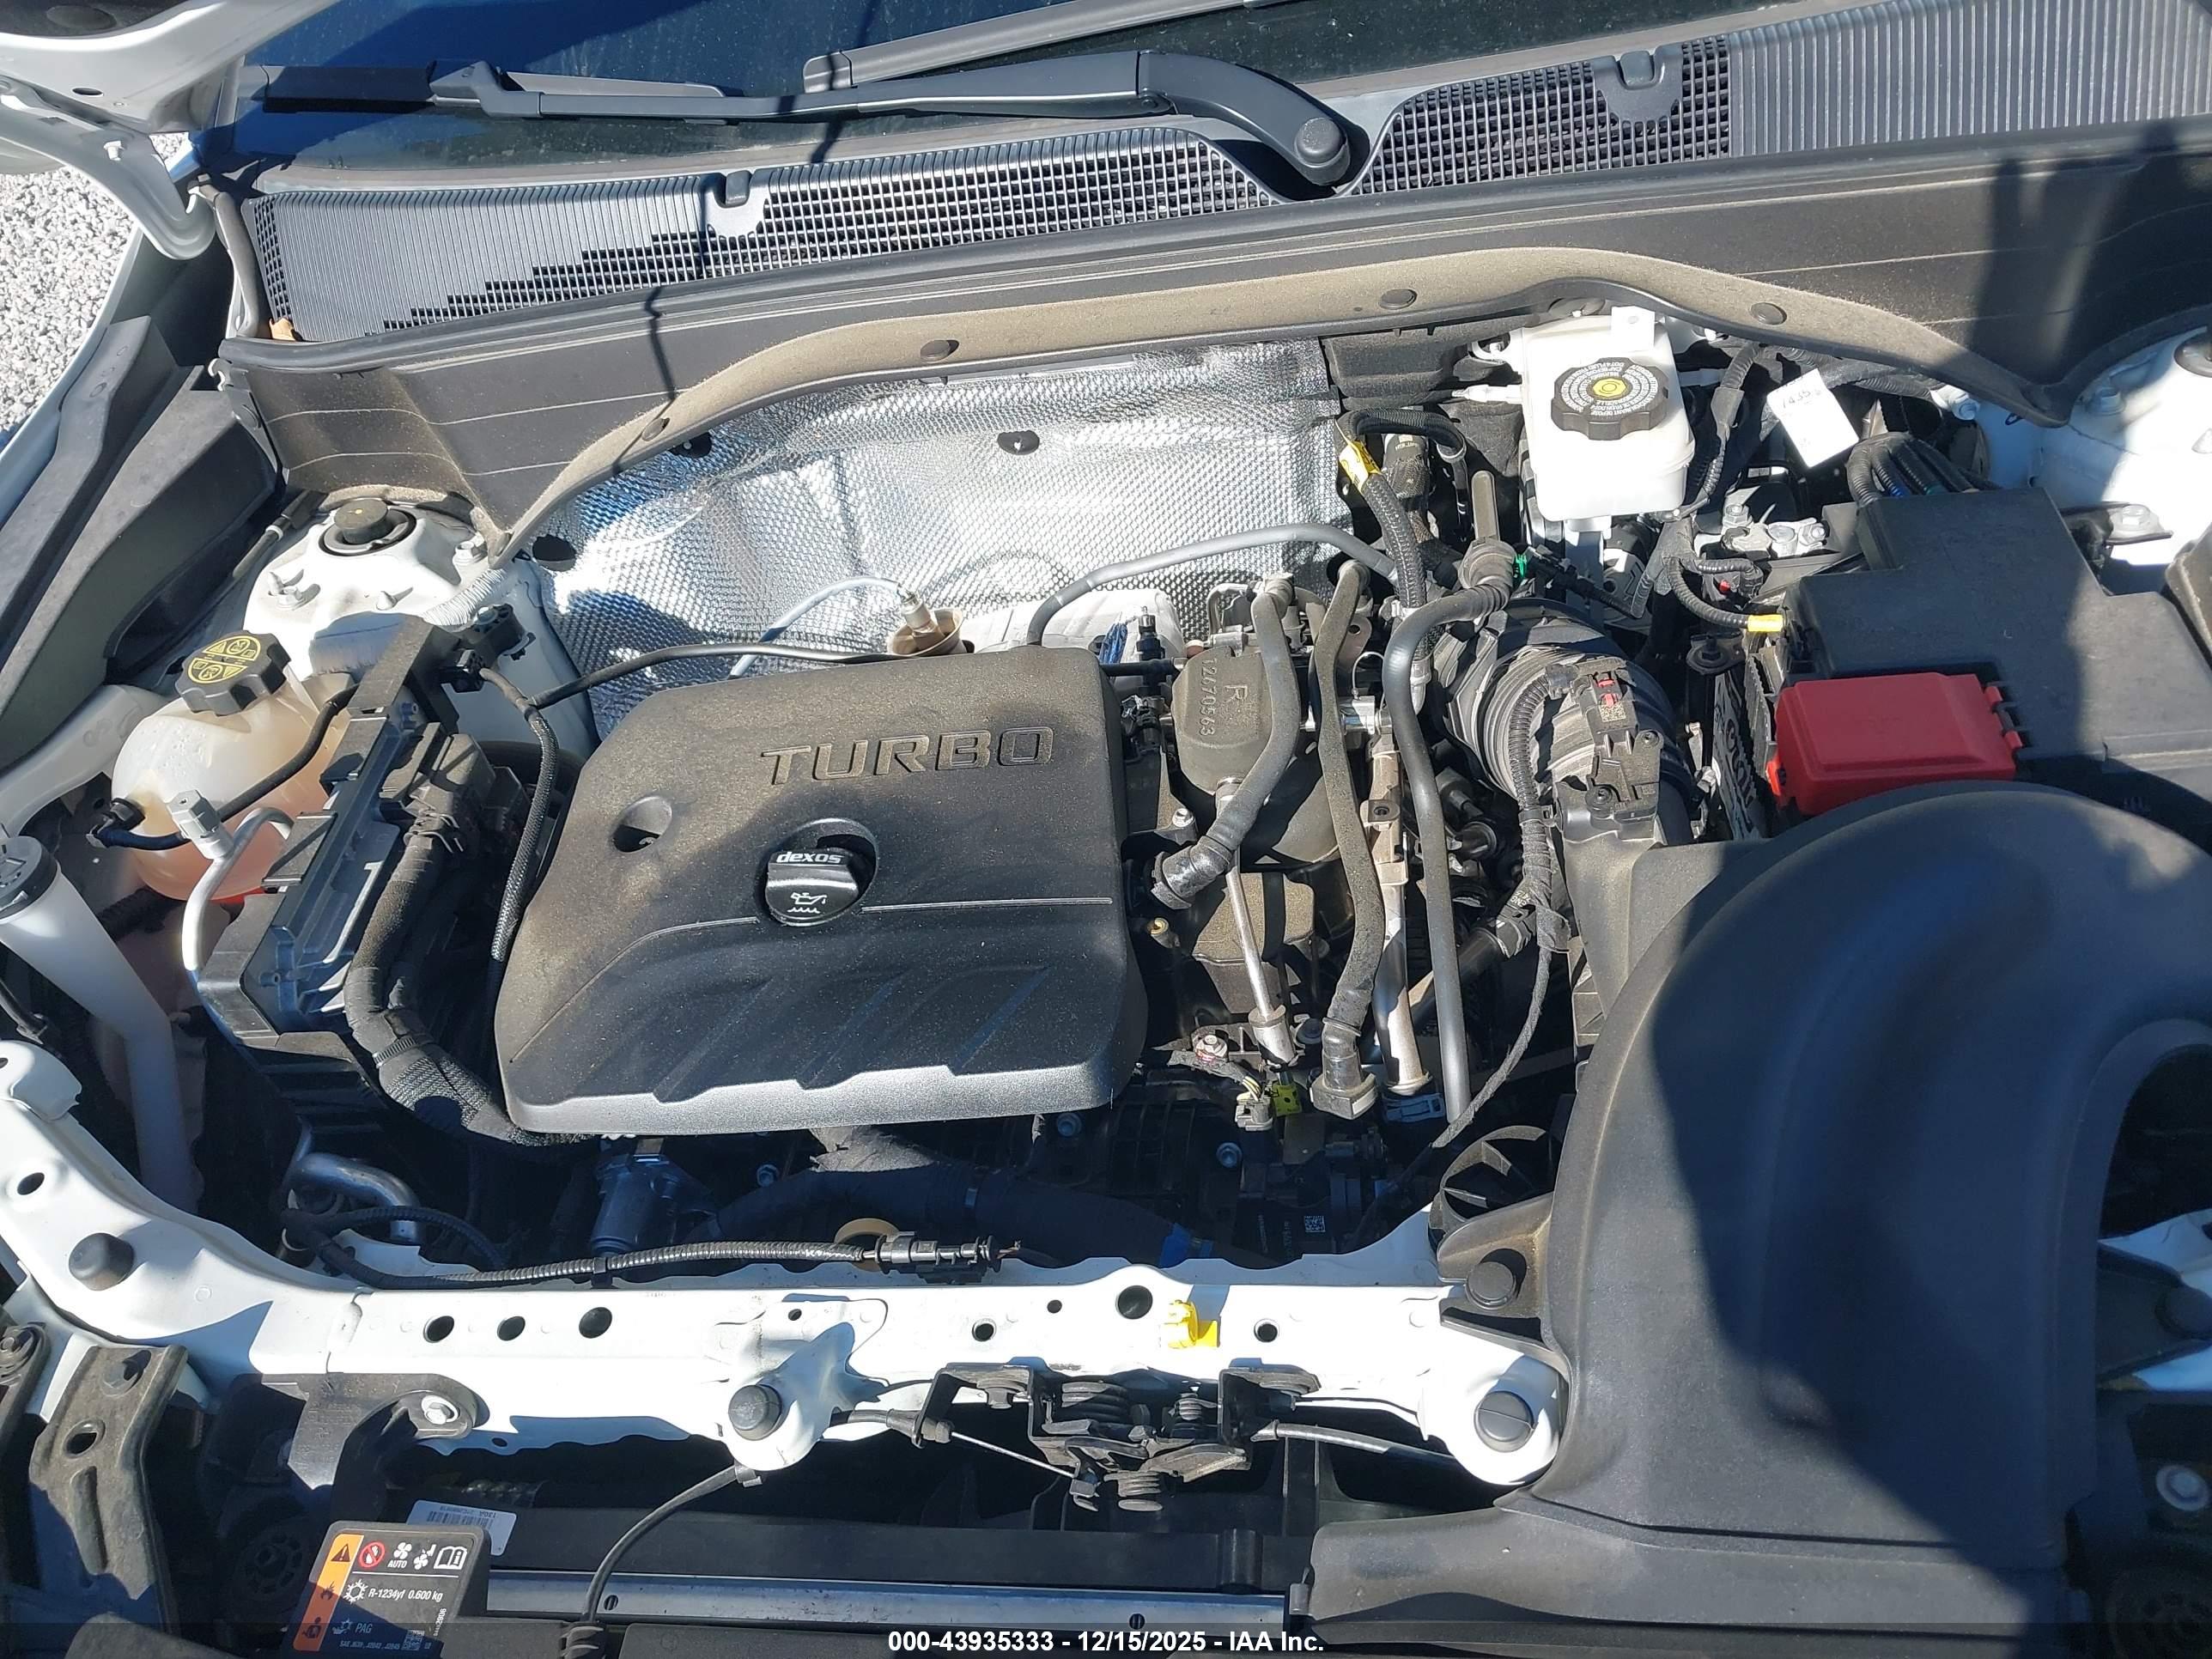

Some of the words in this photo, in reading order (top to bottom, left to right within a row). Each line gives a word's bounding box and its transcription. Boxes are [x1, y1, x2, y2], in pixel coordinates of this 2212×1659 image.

[1200, 658, 1217, 736] 12670563
[1223, 684, 1249, 702] R
[761, 726, 1054, 786] TURBO
[776, 851, 843, 864] dexos
[368, 1589, 405, 1601] R-1234yf
[407, 1590, 431, 1600] 0.600
[432, 1591, 443, 1602] kg
[355, 1623, 373, 1633] PAG
